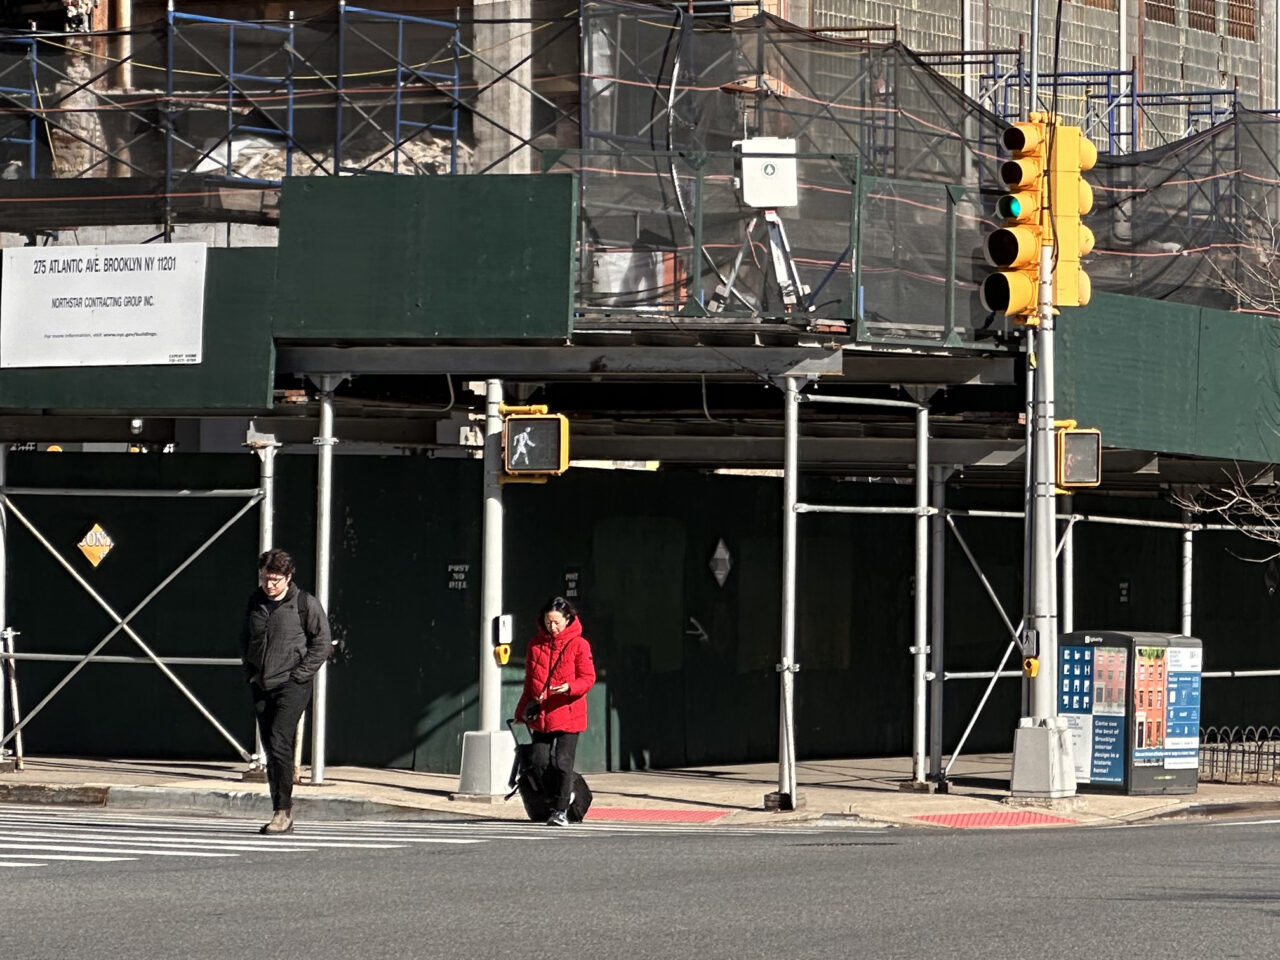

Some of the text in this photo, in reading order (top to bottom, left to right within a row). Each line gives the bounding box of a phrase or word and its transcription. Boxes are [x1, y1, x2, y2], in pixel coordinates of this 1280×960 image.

[33, 259, 46, 274] 275
[49, 258, 83, 273] ATLANTIC
[104, 257, 142, 272] BROOKLYN
[145, 257, 155, 271] NY
[157, 256, 176, 271] 11201
[52, 297, 82, 308] NORTHSTAR
[84, 296, 122, 308] CONTRACTING
[124, 295, 142, 307] GROUP
